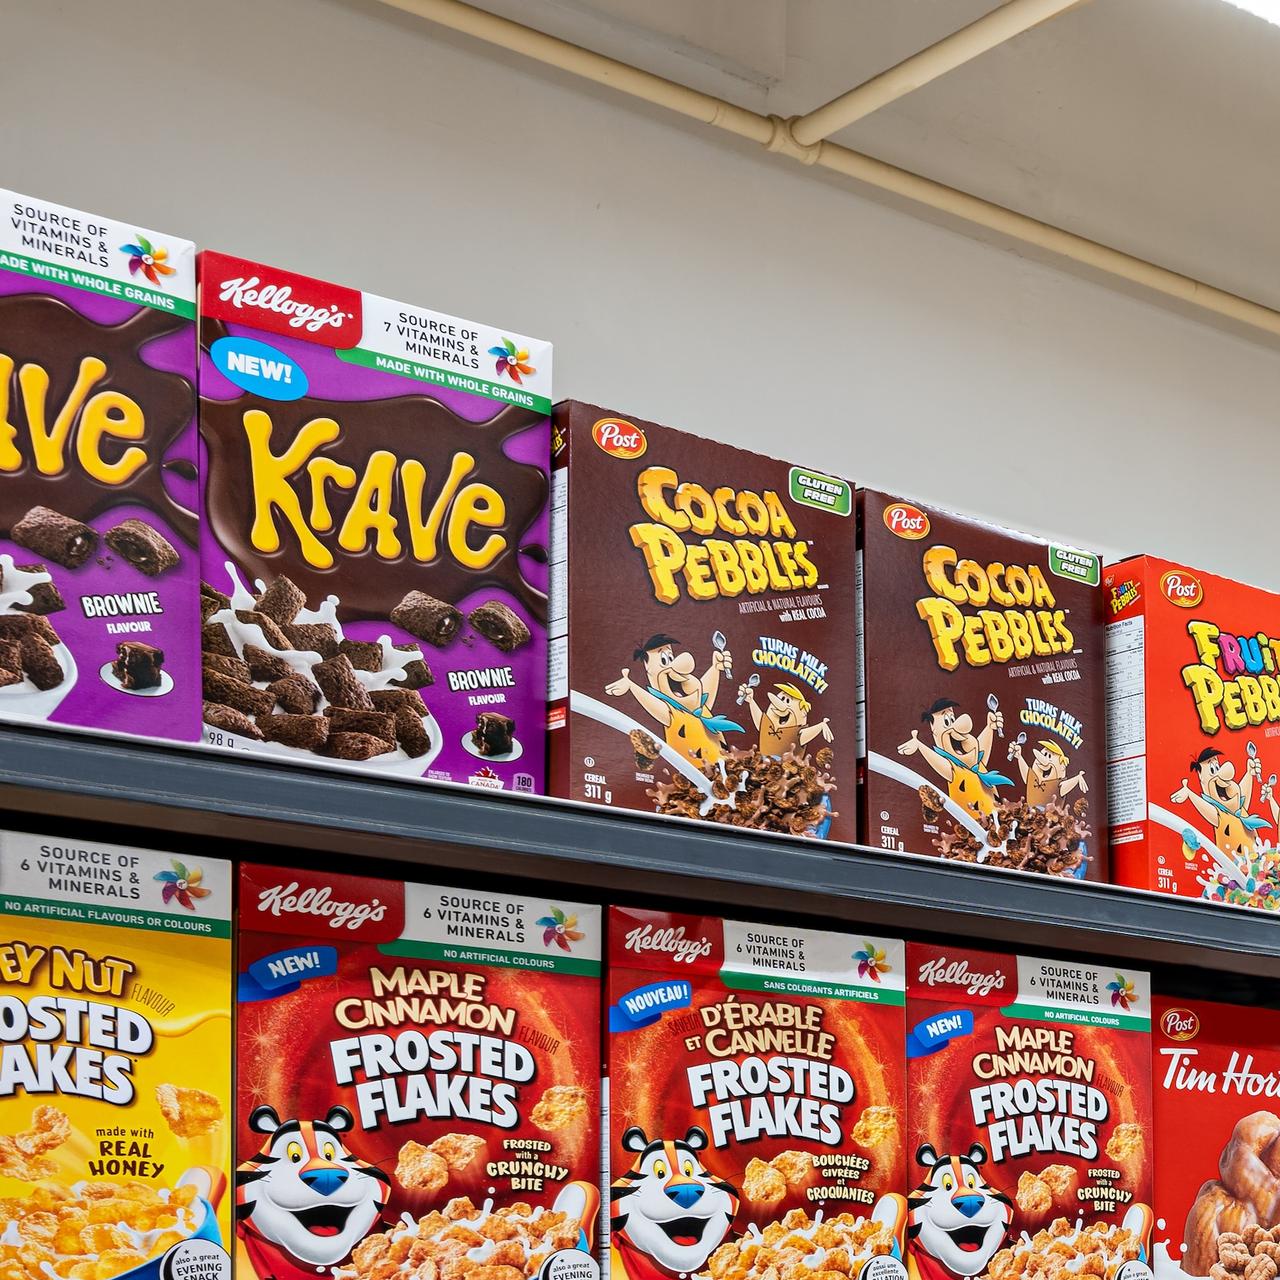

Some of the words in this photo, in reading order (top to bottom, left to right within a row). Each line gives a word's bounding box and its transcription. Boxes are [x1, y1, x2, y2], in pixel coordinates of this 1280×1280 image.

[219, 277, 354, 331] Kellogg's
[384, 322, 391, 332] 7
[398, 323, 464, 352] VITAMINS
[469, 344, 479, 355] &
[399, 312, 452, 334] SOURCE
[457, 328, 480, 340] OF
[226, 352, 293, 383] NEW!
[405, 339, 480, 370] MINERALS
[375, 356, 406, 371] MADE
[410, 362, 441, 378] WITH
[444, 369, 488, 389] WHOLE
[492, 384, 534, 406] GRAINS
[600, 428, 639, 450] Post
[798, 475, 843, 496] GLUTEN
[803, 489, 835, 505] FREE
[637, 466, 796, 538] COCOA
[629, 522, 820, 605] PEBBLES
[752, 649, 827, 694] CHOCOLATEY!
[759, 636, 797, 660] TURNS
[799, 648, 828, 676] MILK
[448, 667, 515, 691] BROWNIE
[468, 692, 506, 706] FLAVOUR
[585, 774, 607, 785] CEREAL
[585, 784, 602, 799] 311
[605, 789, 612, 803] g
[257, 882, 388, 928] Kellogg's
[268, 952, 320, 978] NEW!
[444, 950, 457, 958] NO
[460, 951, 511, 965] ARTIFICIAL
[514, 957, 555, 968] COLOURS
[371, 966, 486, 1005] MAPLE
[625, 983, 689, 1014] NOUVEAU!
[764, 981, 786, 991] SANS
[788, 983, 834, 996] COLORANTS
[834, 987, 880, 1001] ARTIFICIELS
[335, 998, 516, 1036] CINNAMON
[701, 994, 824, 1032] D'ÉRABLE
[330, 1030, 536, 1086] FROSTED
[685, 1035, 702, 1053] ET
[705, 1029, 836, 1061] CANNELLE
[1159, 1048, 1216, 1090] Tim
[354, 1072, 522, 1132] FLAKES
[100, 1141, 152, 1158] REAL
[813, 1155, 870, 1171] BOUCHÉES
[88, 1160, 164, 1178] HONEY
[821, 1166, 859, 1180] GIVRÉES
[807, 1186, 874, 1205] CROQUANTES
